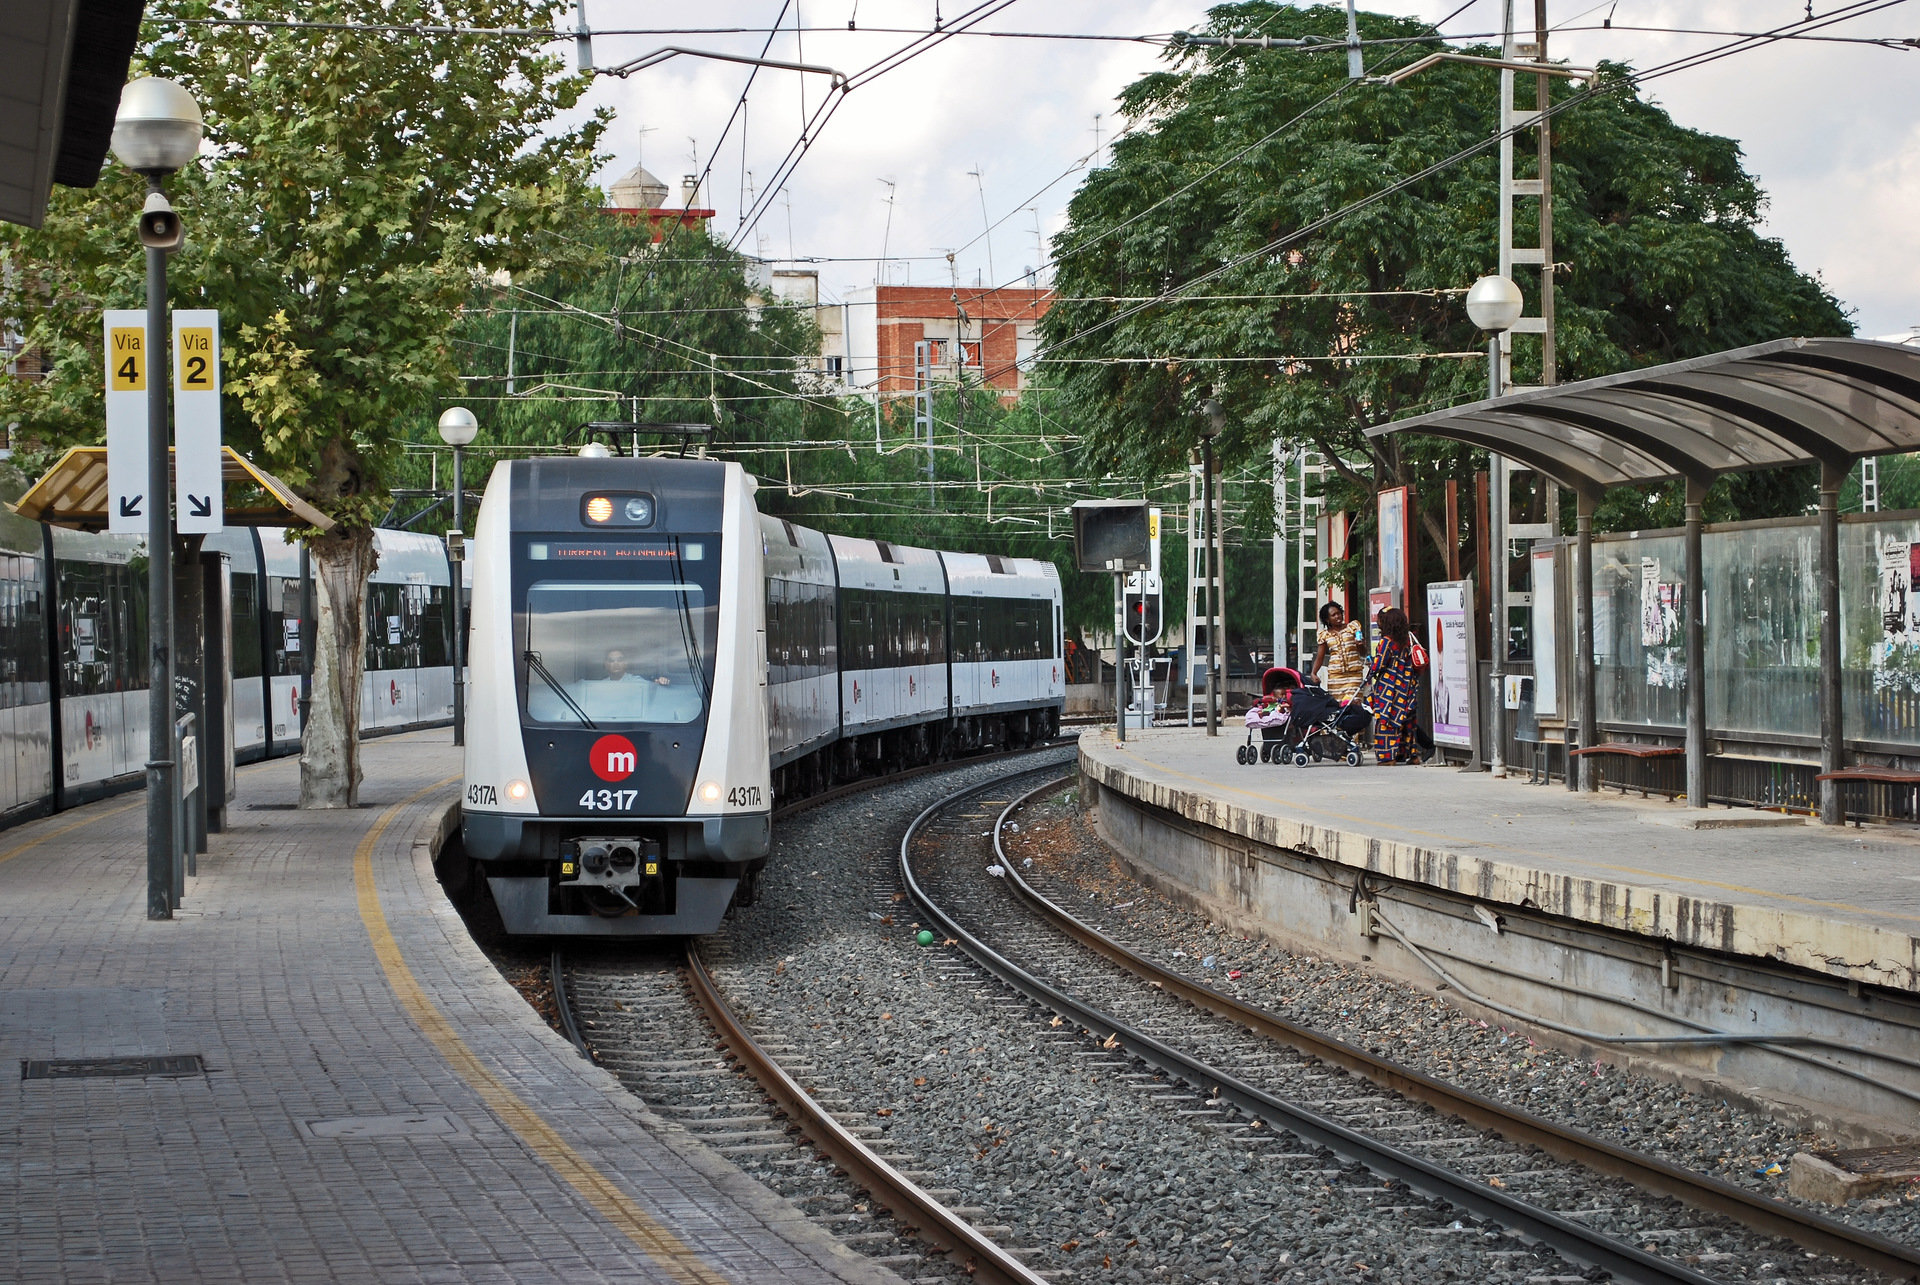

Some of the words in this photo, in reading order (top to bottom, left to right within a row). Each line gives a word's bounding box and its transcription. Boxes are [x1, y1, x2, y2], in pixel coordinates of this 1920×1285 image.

[114, 332, 141, 351] Via
[182, 332, 209, 351] Via
[117, 356, 139, 384] 4
[186, 356, 208, 384] 2
[1150, 525, 1156, 537] 3
[467, 784, 498, 806] 4317A
[579, 788, 638, 811] 4317
[728, 785, 762, 807] 4317A
